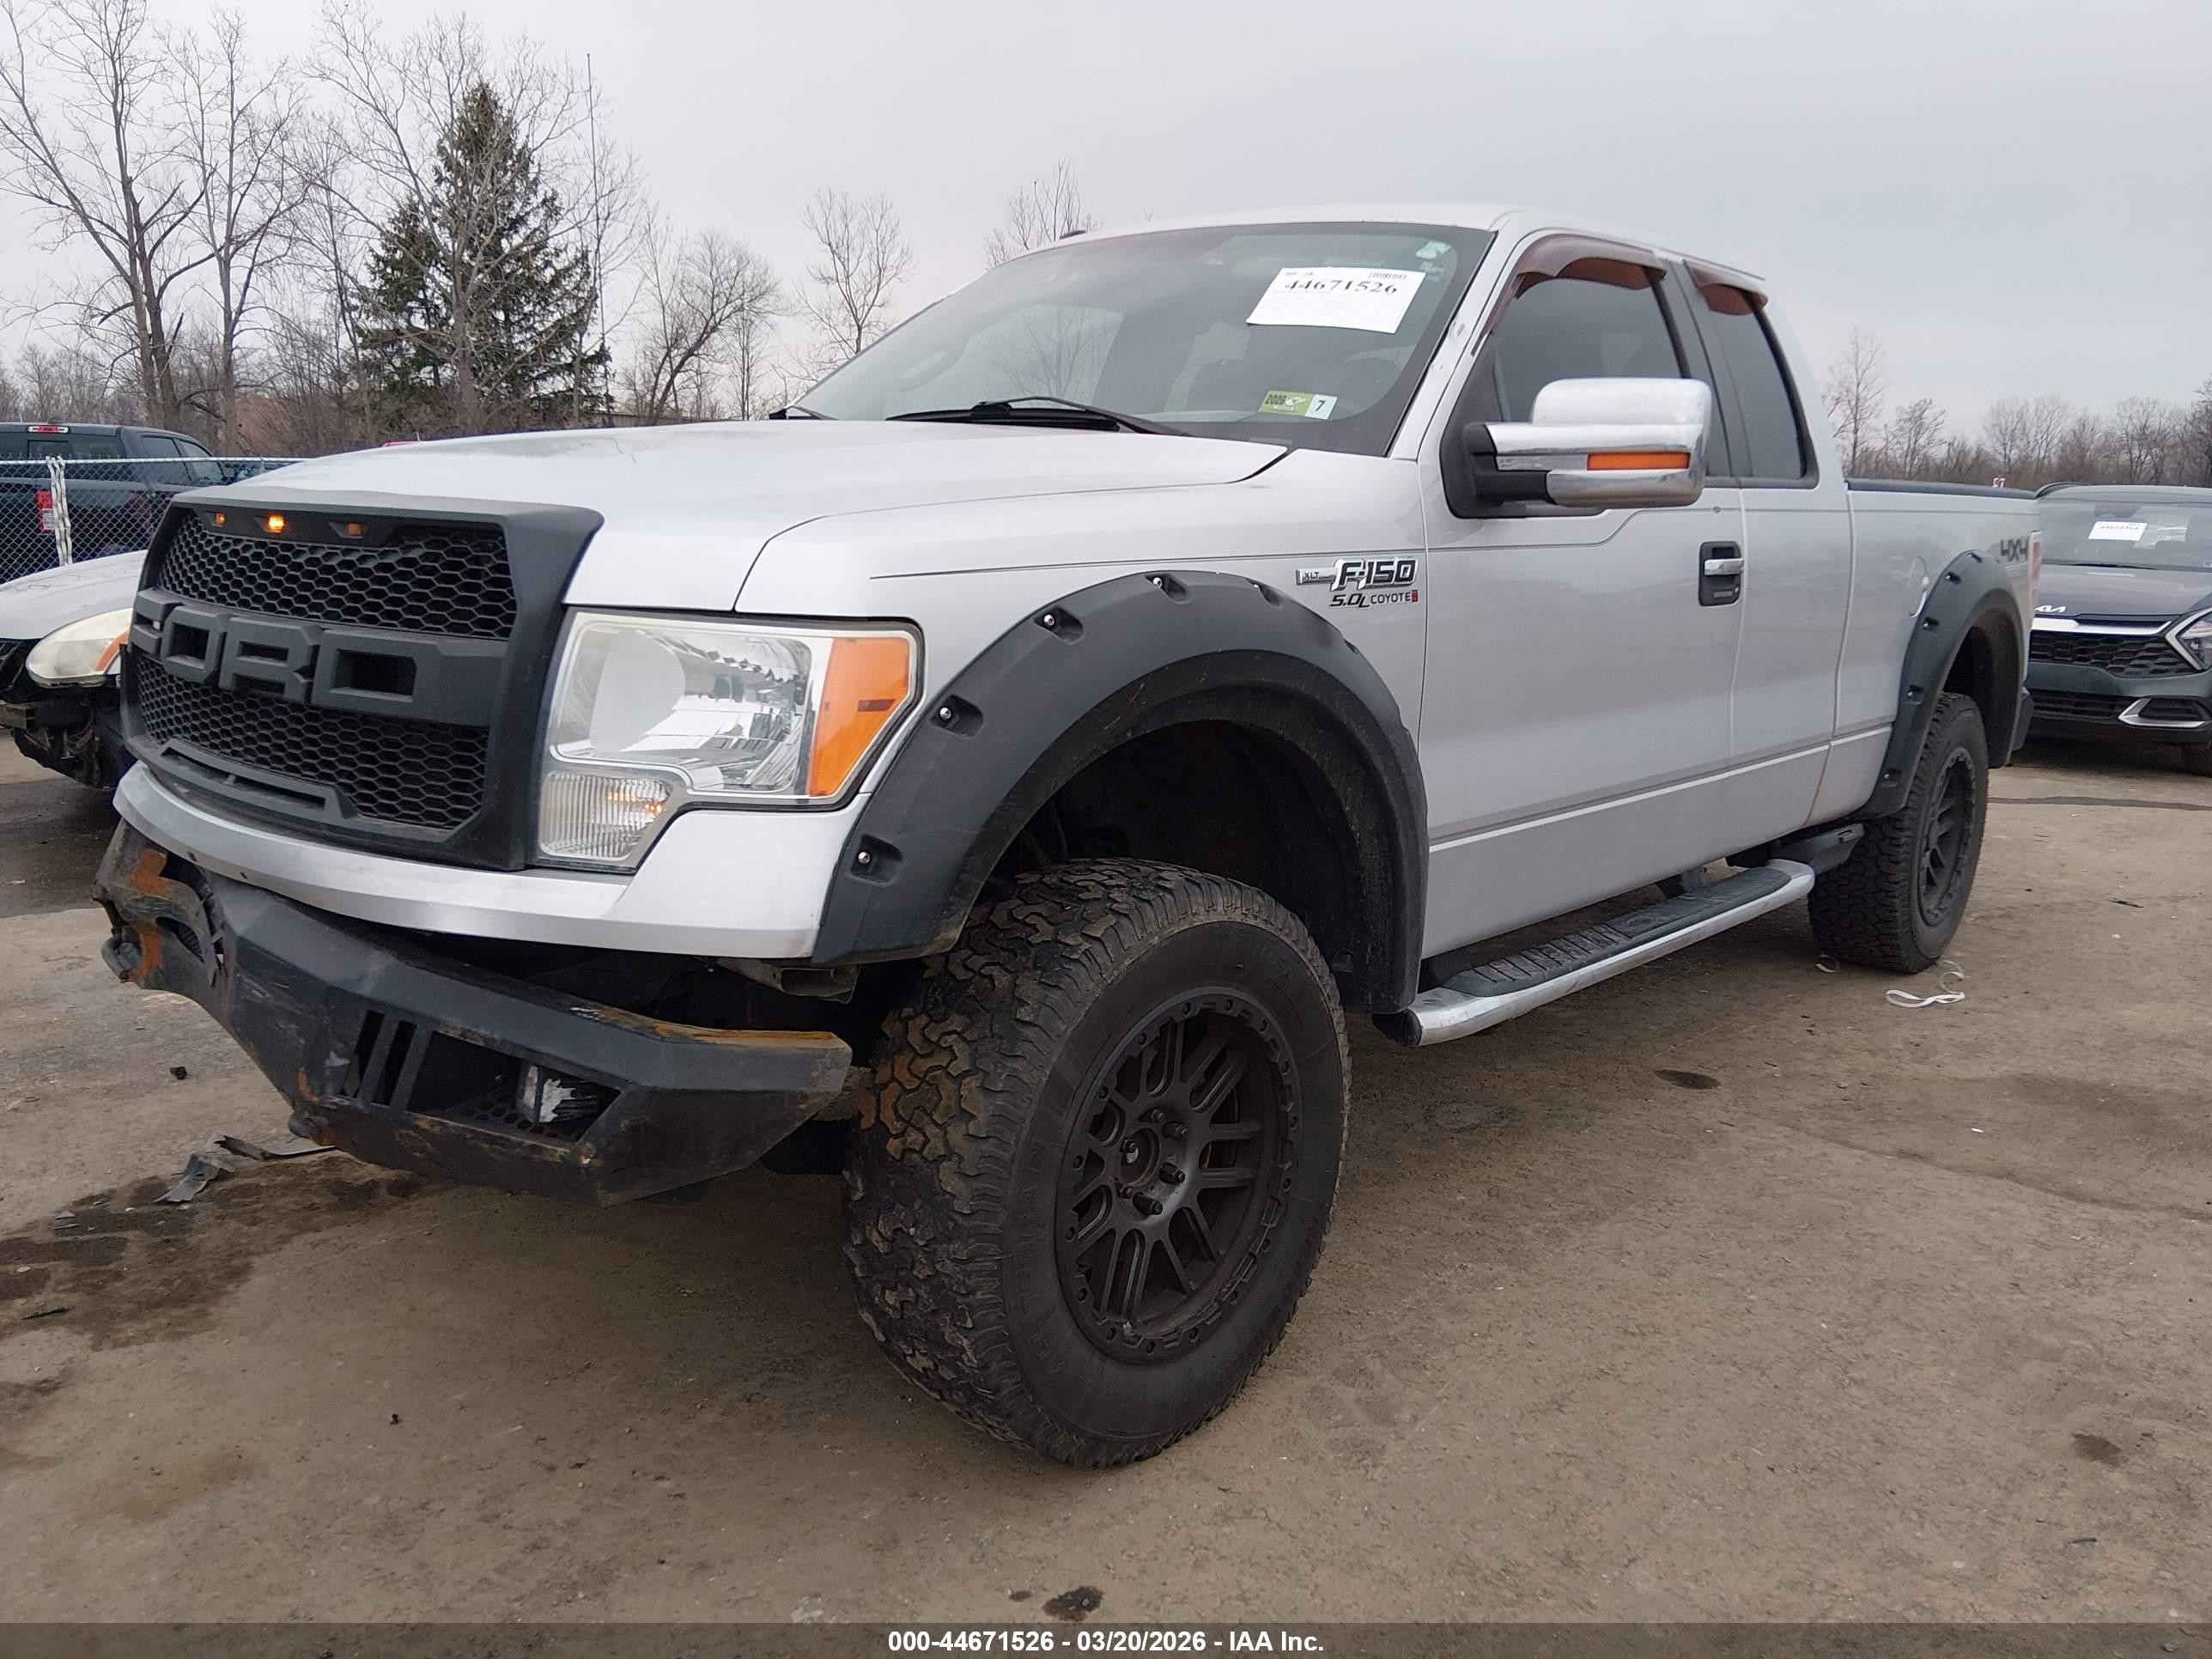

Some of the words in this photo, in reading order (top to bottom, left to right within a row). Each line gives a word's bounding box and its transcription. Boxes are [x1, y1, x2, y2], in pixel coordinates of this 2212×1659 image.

[1285, 279, 1398, 295] 44671526
[1315, 399, 1327, 412] 7
[1304, 571, 1320, 580] XLT
[1332, 558, 1418, 590] F-150
[1330, 592, 1370, 608] 5.0L
[1370, 592, 1411, 605] COYOTE
[130, 590, 440, 714] FORD
